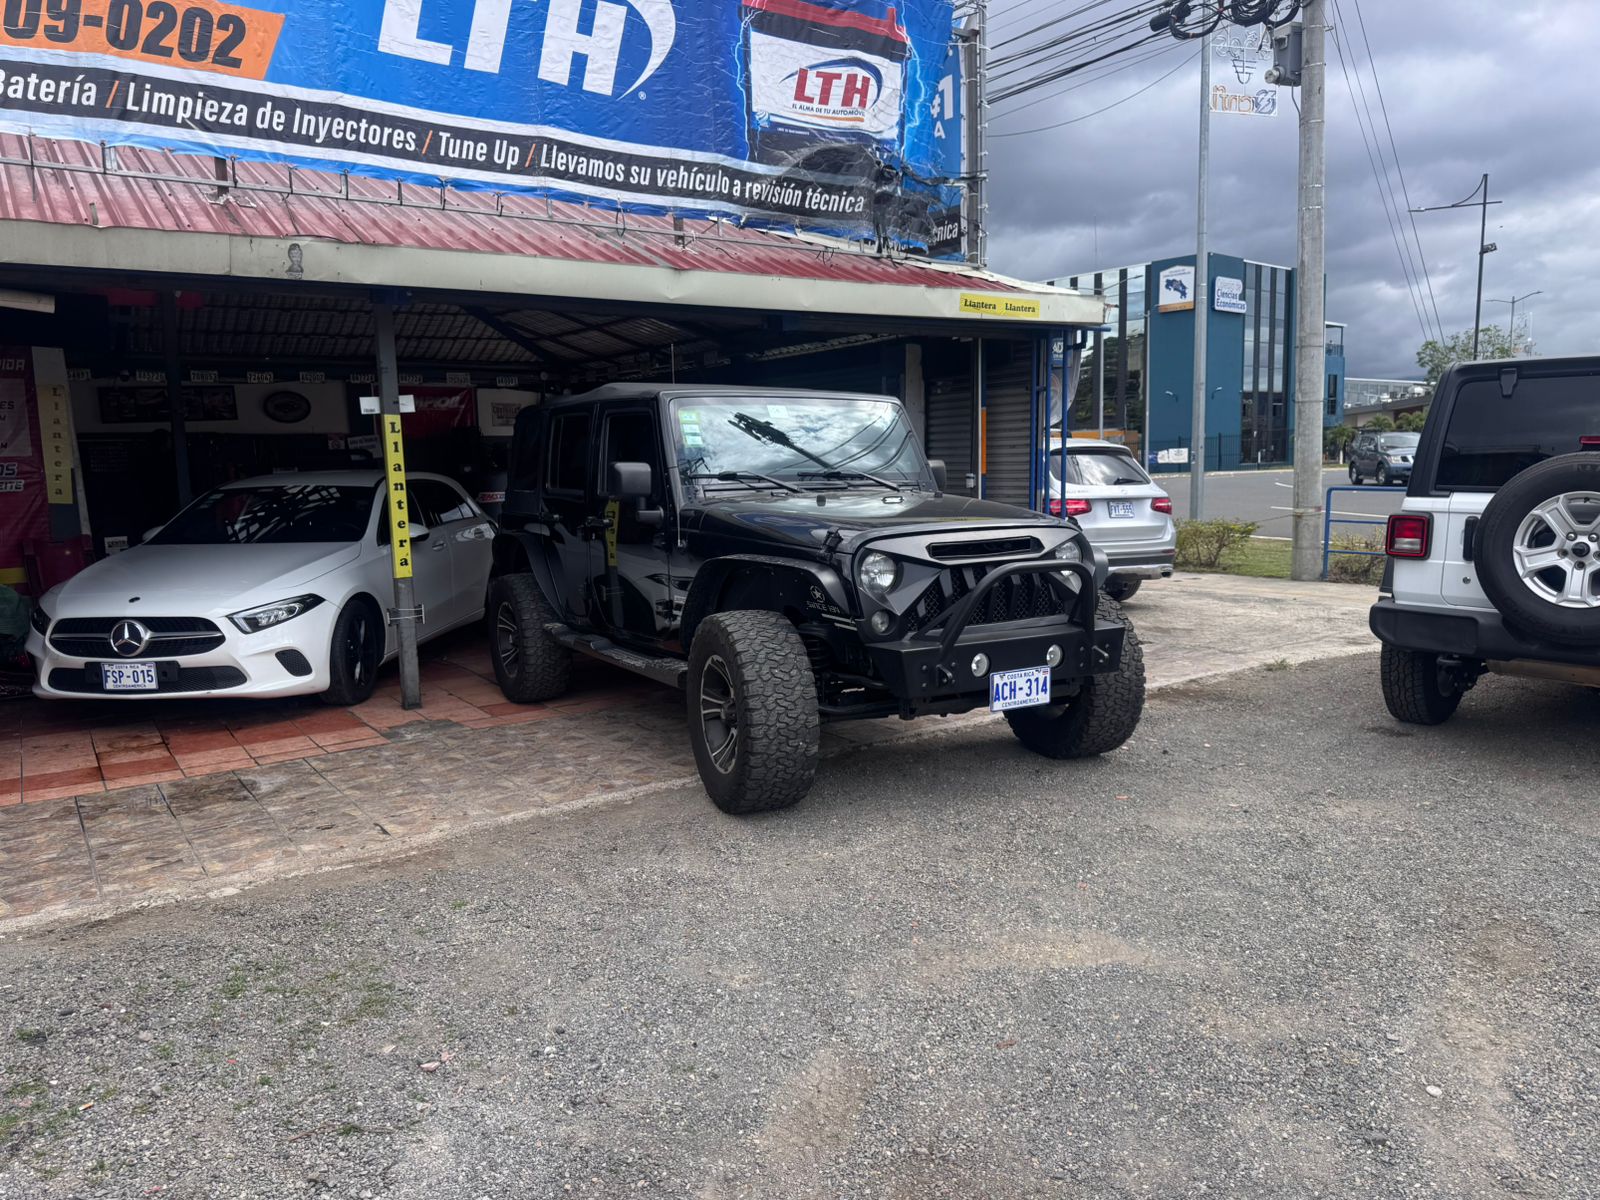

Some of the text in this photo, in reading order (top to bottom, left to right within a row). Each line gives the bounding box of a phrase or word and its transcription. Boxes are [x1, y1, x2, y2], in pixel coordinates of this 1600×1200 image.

[794, 67, 871, 109] LTH
[799, 105, 815, 113] ALMA
[815, 106, 823, 114] DE
[126, 81, 248, 126] Limpieza
[256, 101, 286, 132] de
[293, 108, 418, 152] Inyectores
[439, 131, 487, 162] Tune
[493, 140, 520, 171] Up
[540, 143, 626, 181] Llevamos
[631, 165, 652, 186] su
[656, 165, 730, 195] vehículo
[732, 179, 741, 197] a
[745, 180, 802, 208] revisión
[804, 187, 865, 213] técnica
[963, 298, 1036, 313] Llantera Llantera
[1216, 288, 1238, 300] Ciencias
[52, 387, 63, 496] Llantera
[389, 421, 409, 567] Llantera
[104, 669, 155, 684] FSP-015
[993, 675, 1048, 703] ACH-314
